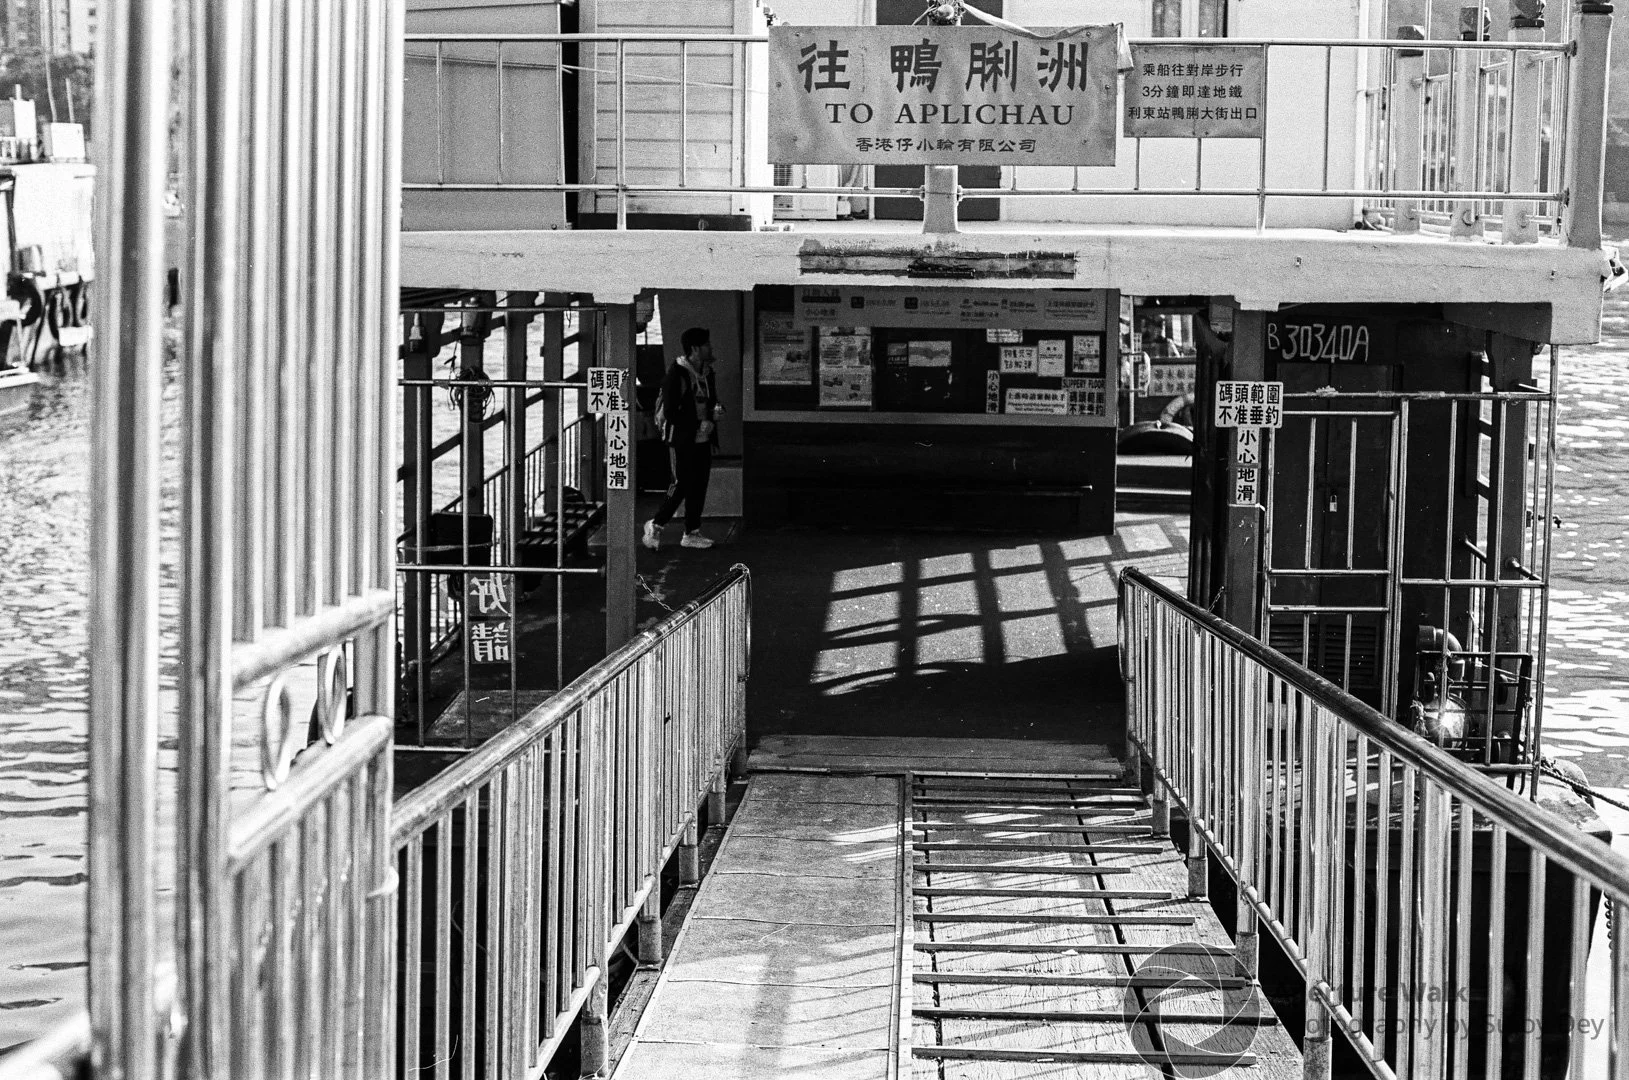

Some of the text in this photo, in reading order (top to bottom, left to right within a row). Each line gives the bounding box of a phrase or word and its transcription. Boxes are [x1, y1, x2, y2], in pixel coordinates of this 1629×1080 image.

[797, 39, 1089, 93] 往鴨脷洲
[1142, 63, 1245, 78] 乘船往對岸步行
[1141, 84, 1243, 99] 3分鐘即達地鐵
[825, 102, 1076, 126] TO APLICHAU
[1127, 106, 1258, 121] 利東站鴨脷大街出口
[855, 136, 1037, 154] 香港仔小輪有限公司
[1267, 323, 1370, 363] B 30340A
[1218, 383, 1281, 405] 碼頭範圍
[1218, 405, 1280, 426] 不准垂釣
[609, 416, 628, 487] 小心地滑
[1237, 429, 1257, 501] 小心地滑
